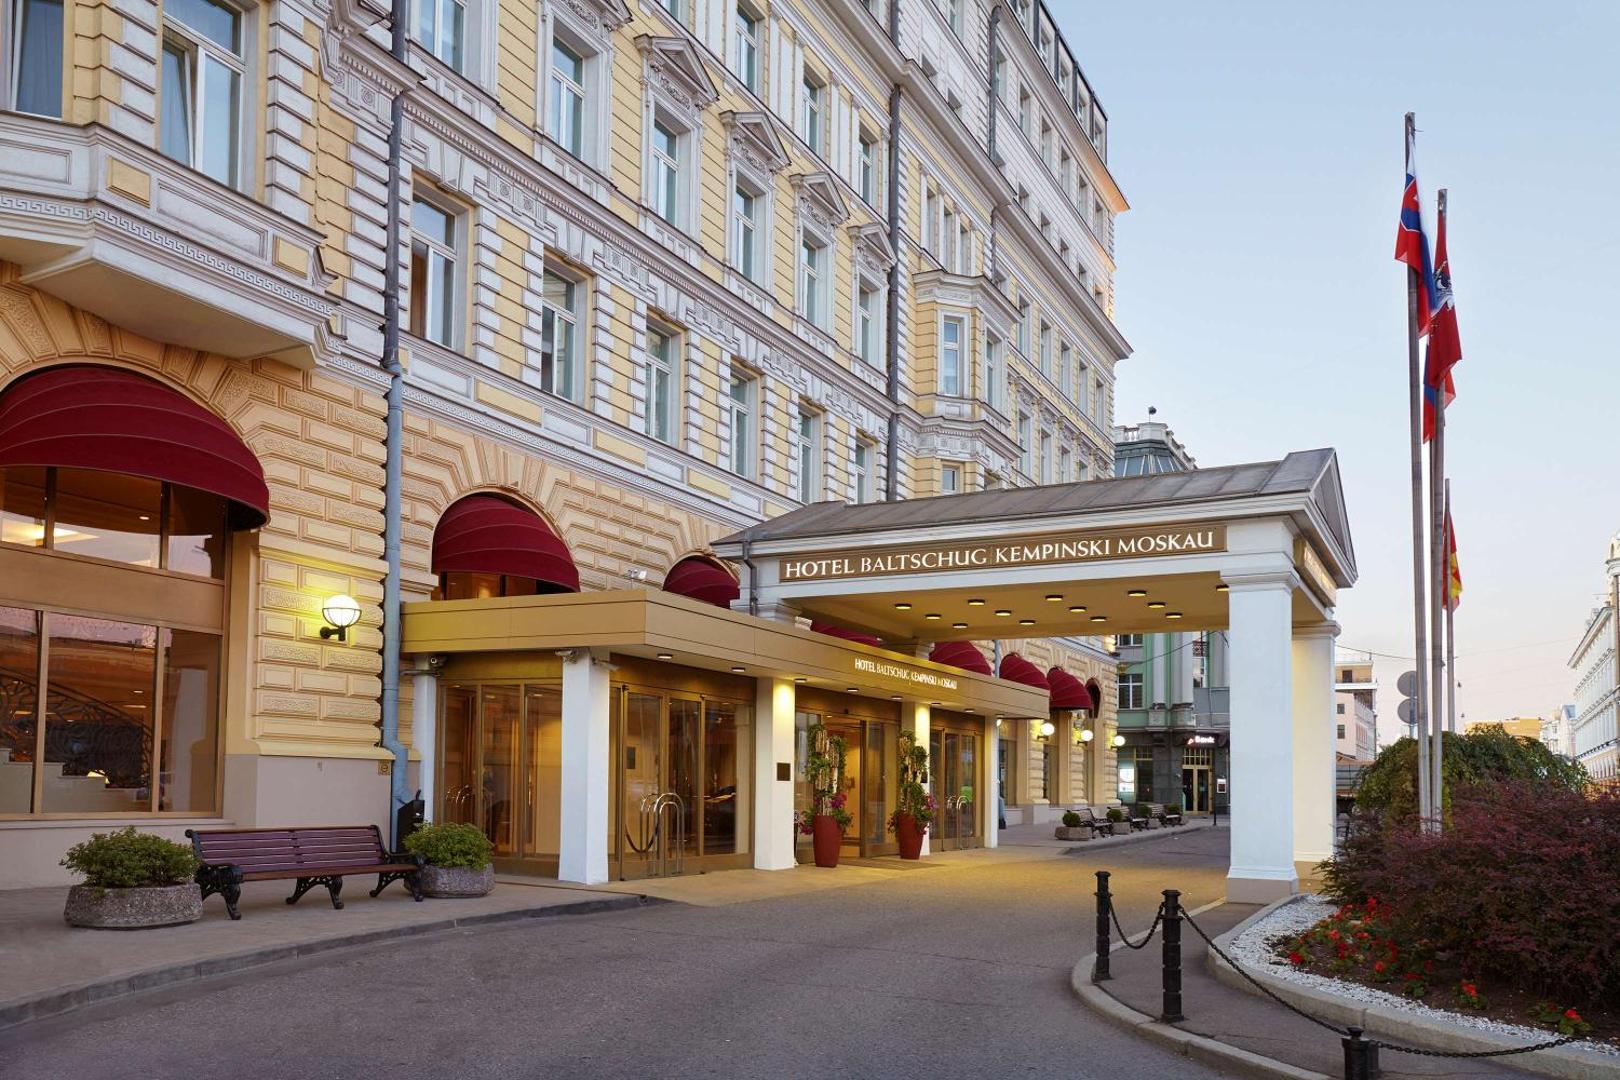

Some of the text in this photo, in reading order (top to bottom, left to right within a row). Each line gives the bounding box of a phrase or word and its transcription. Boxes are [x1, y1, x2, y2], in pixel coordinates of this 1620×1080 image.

[786, 531, 1214, 578] HOTEL BALTSCHUG KEMPINSKI MOSKAU
[854, 658, 876, 673] HOTEL
